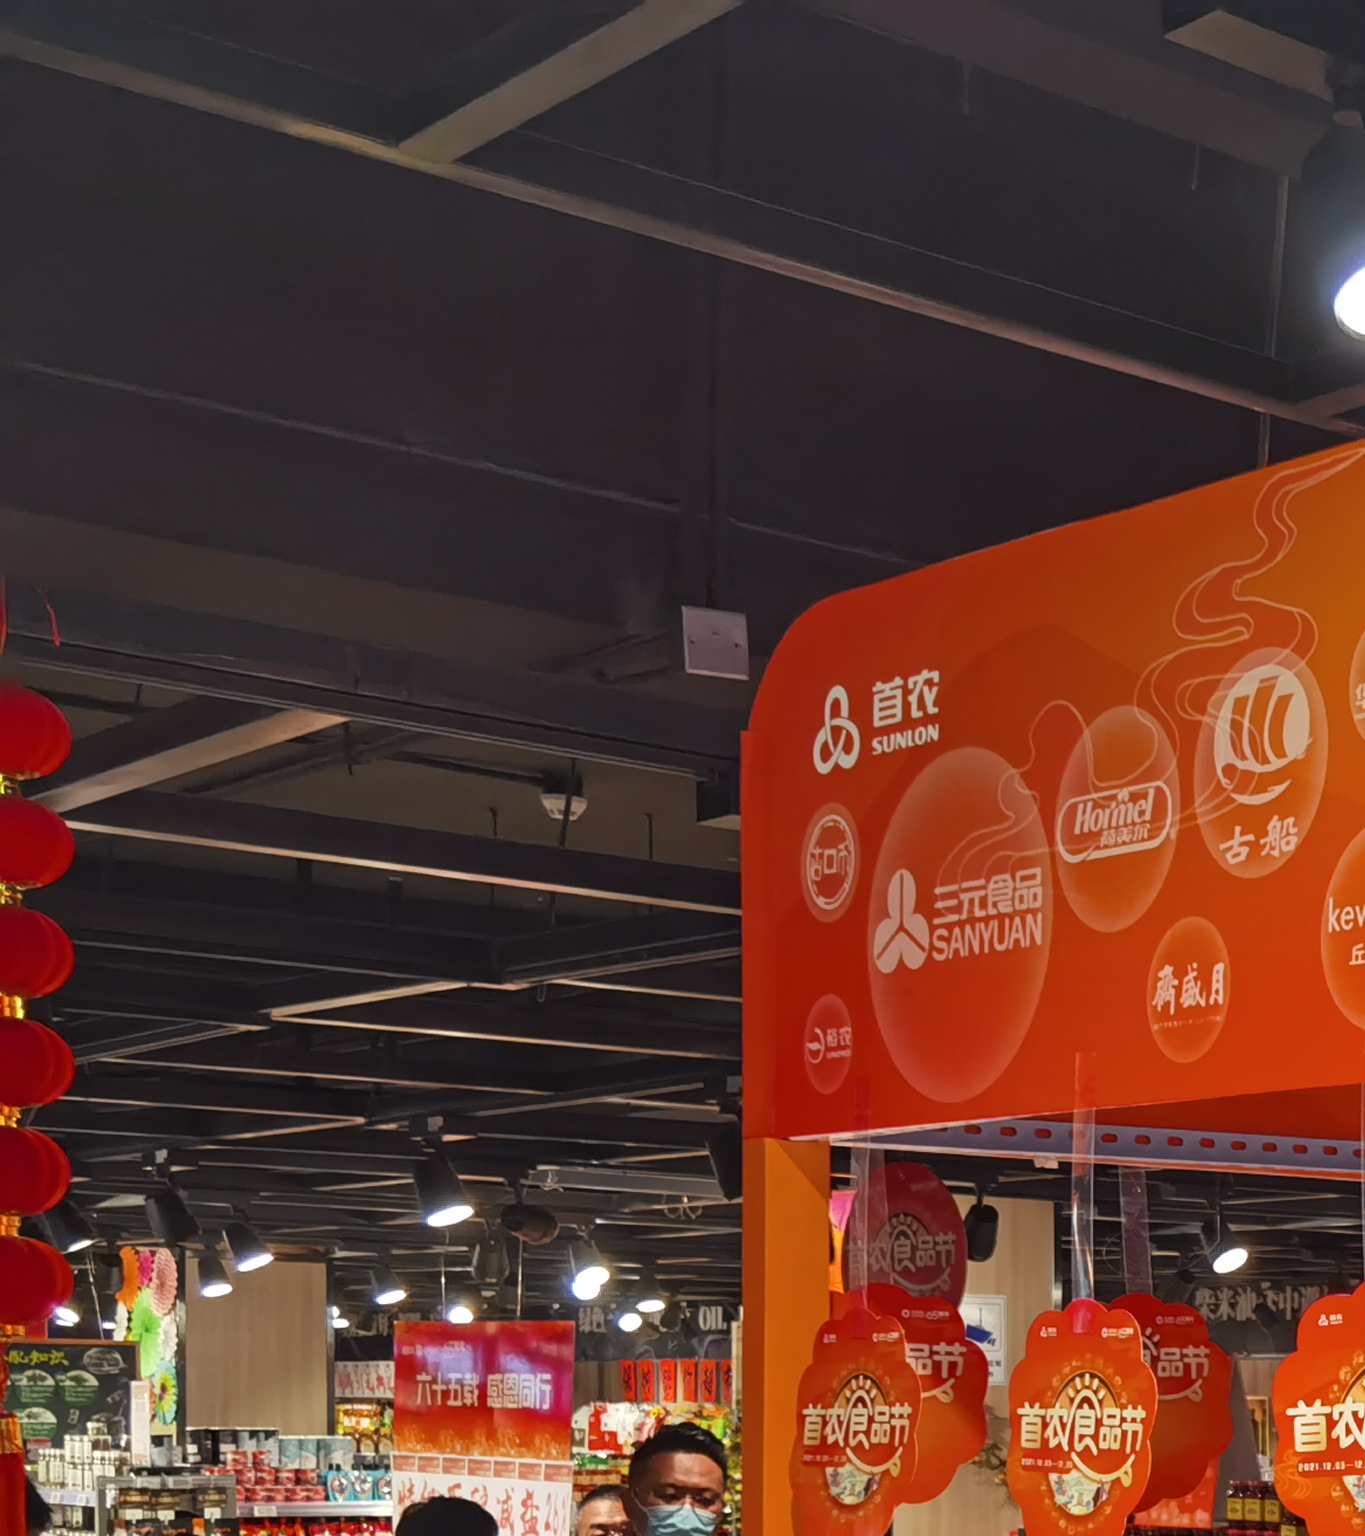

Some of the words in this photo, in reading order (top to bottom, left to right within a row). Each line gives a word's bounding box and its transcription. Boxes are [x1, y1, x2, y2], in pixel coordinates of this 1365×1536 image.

[872, 669, 939, 727] 首农
[872, 724, 939, 755] SUNLON
[1074, 787, 1155, 834] Hormel
[1219, 814, 1298, 865] 古船
[934, 867, 1042, 924] 三元食品
[932, 912, 1042, 961] SANYUAN
[487, 1372, 552, 1410] 感恩同行
[802, 1390, 913, 1456] 首农食品节
[1017, 1390, 1146, 1456] 首农食品节
